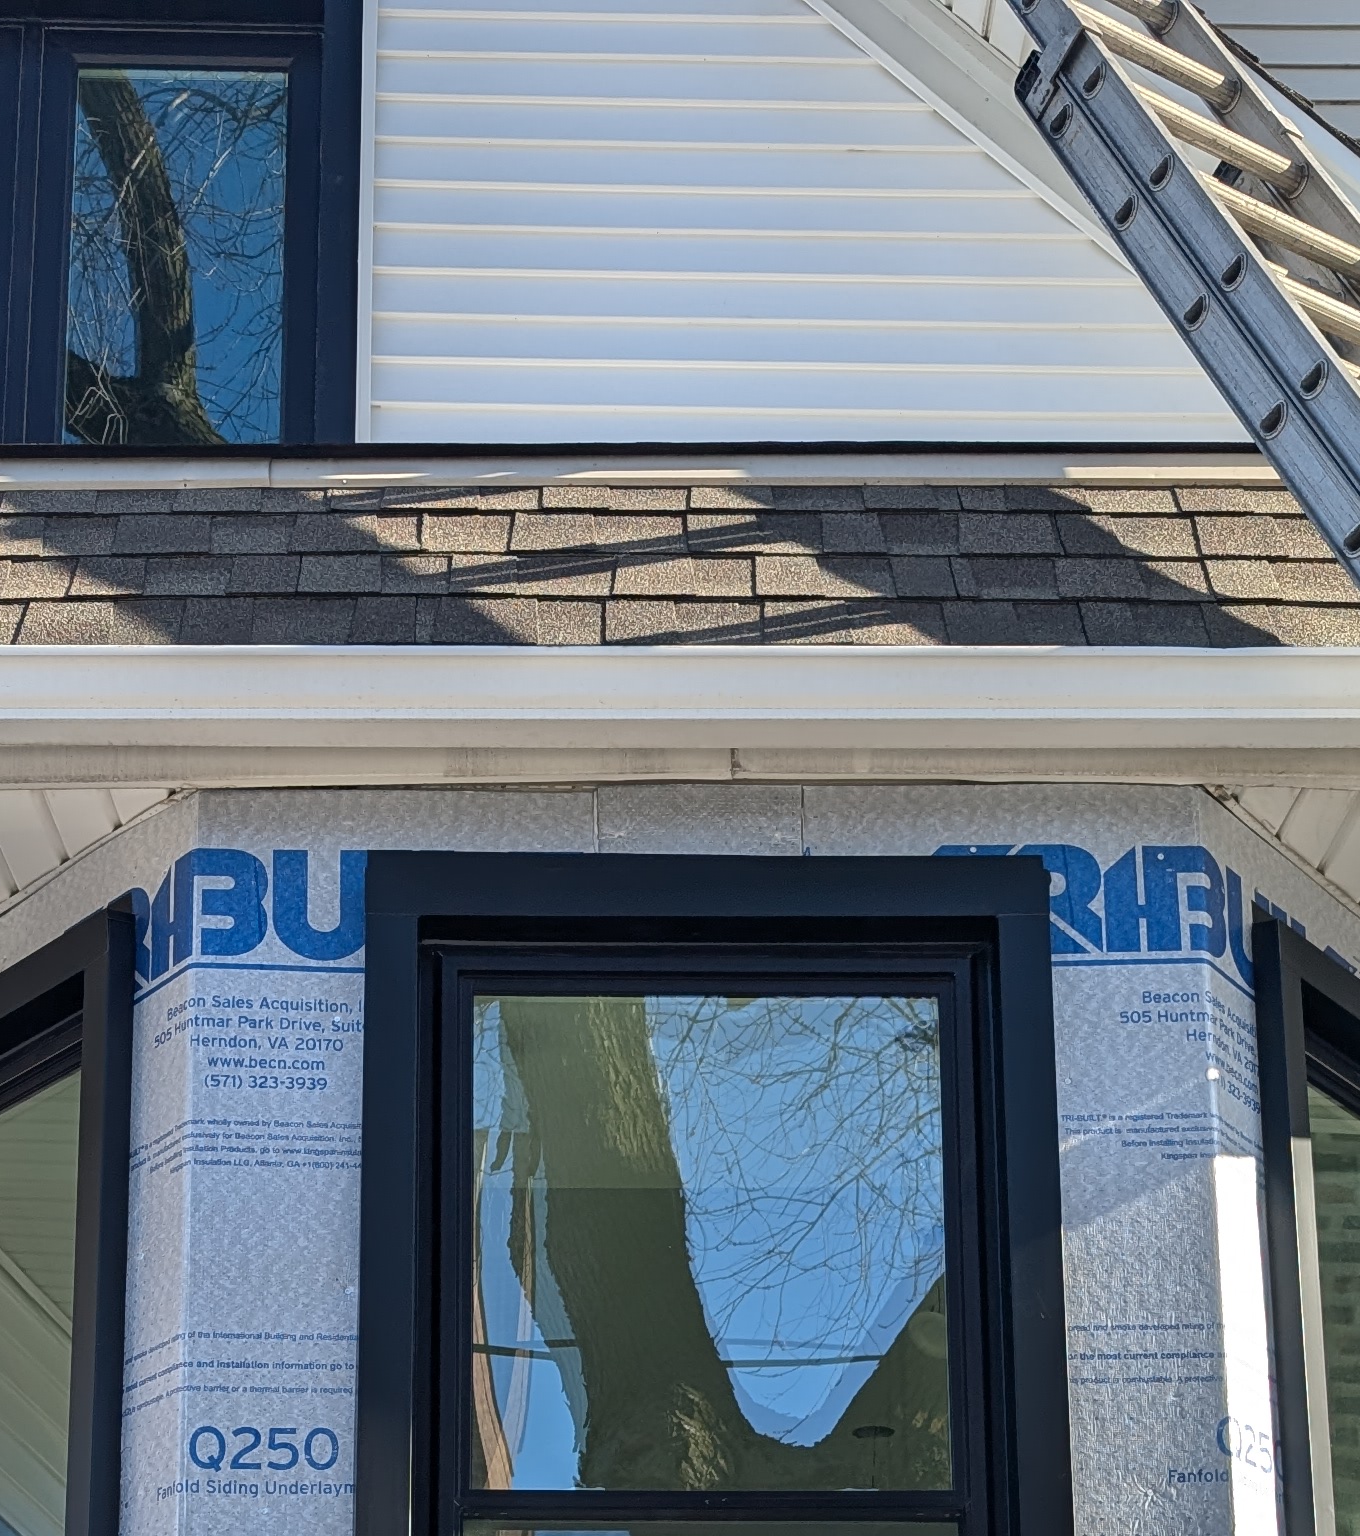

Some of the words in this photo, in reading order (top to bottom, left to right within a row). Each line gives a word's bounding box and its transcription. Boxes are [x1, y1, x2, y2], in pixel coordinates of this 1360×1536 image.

[1142, 990, 1200, 1004] Beacon
[167, 995, 206, 1021] Beacon
[212, 995, 254, 1009] Sales
[259, 996, 353, 1015] Acquisition,
[1120, 1010, 1152, 1024] 505
[1157, 1009, 1218, 1024] Huntmar
[154, 1026, 172, 1049] 505
[174, 1015, 232, 1036] Huntmar
[238, 1015, 273, 1029] Park
[280, 1018, 325, 1034] Drive,
[190, 1034, 262, 1050] Herndon,
[268, 1037, 289, 1049] VA
[295, 1038, 343, 1051] 20170
[207, 1055, 325, 1071] www.becn.com
[204, 1075, 242, 1089] (571)
[248, 1076, 328, 1090] 323-3939
[1121, 1139, 1147, 1148] Before
[187, 1331, 196, 1340] of
[299, 1332, 314, 1341] and
[1079, 1352, 1095, 1361] the
[1097, 1353, 1122, 1361] most
[1124, 1352, 1158, 1361] current
[1160, 1351, 1215, 1361] compliance
[196, 1359, 214, 1369] and
[217, 1360, 270, 1369] installation
[272, 1360, 327, 1370] information
[330, 1362, 342, 1371] go
[344, 1362, 355, 1370] to
[232, 1385, 240, 1393] or
[319, 1386, 353, 1396] required
[189, 1425, 340, 1473] Q250
[1168, 1468, 1229, 1484] Fanfold
[157, 1479, 200, 1501] Fanfold
[206, 1479, 259, 1497] Siding
